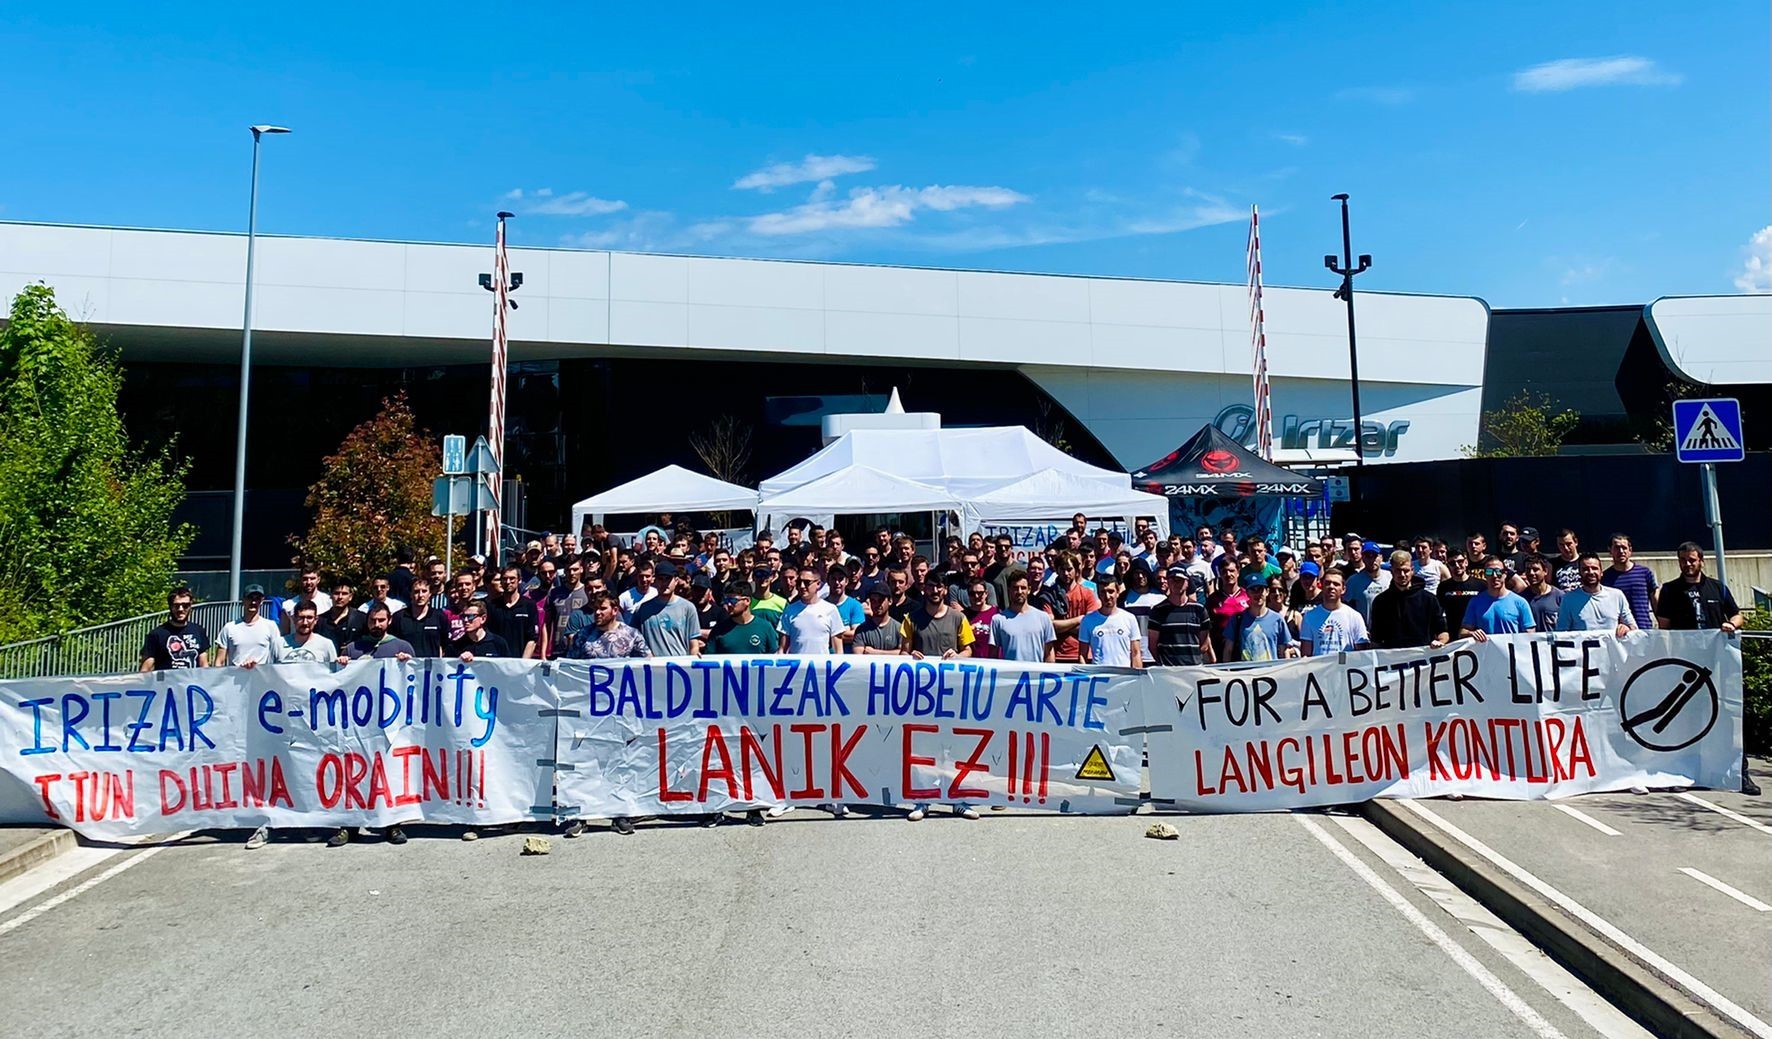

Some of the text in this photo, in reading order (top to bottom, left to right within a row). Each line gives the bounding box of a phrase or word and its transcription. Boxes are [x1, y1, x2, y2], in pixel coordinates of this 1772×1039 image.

[1281, 414, 1411, 457] Irizar
[1164, 484, 1219, 496] 24MX
[1256, 483, 1311, 494] 24MX
[17, 663, 499, 756] IRIZAR e-mobility
[589, 659, 1111, 730] BALDINTZAK HOBETU ARTE
[1196, 639, 1601, 730] FOR A BETTER LIFE
[35, 745, 486, 823] ITUN DUINA ORAIN!!!
[658, 723, 869, 802] LANIK
[1196, 715, 1597, 795] LANGILEON KONTURA
